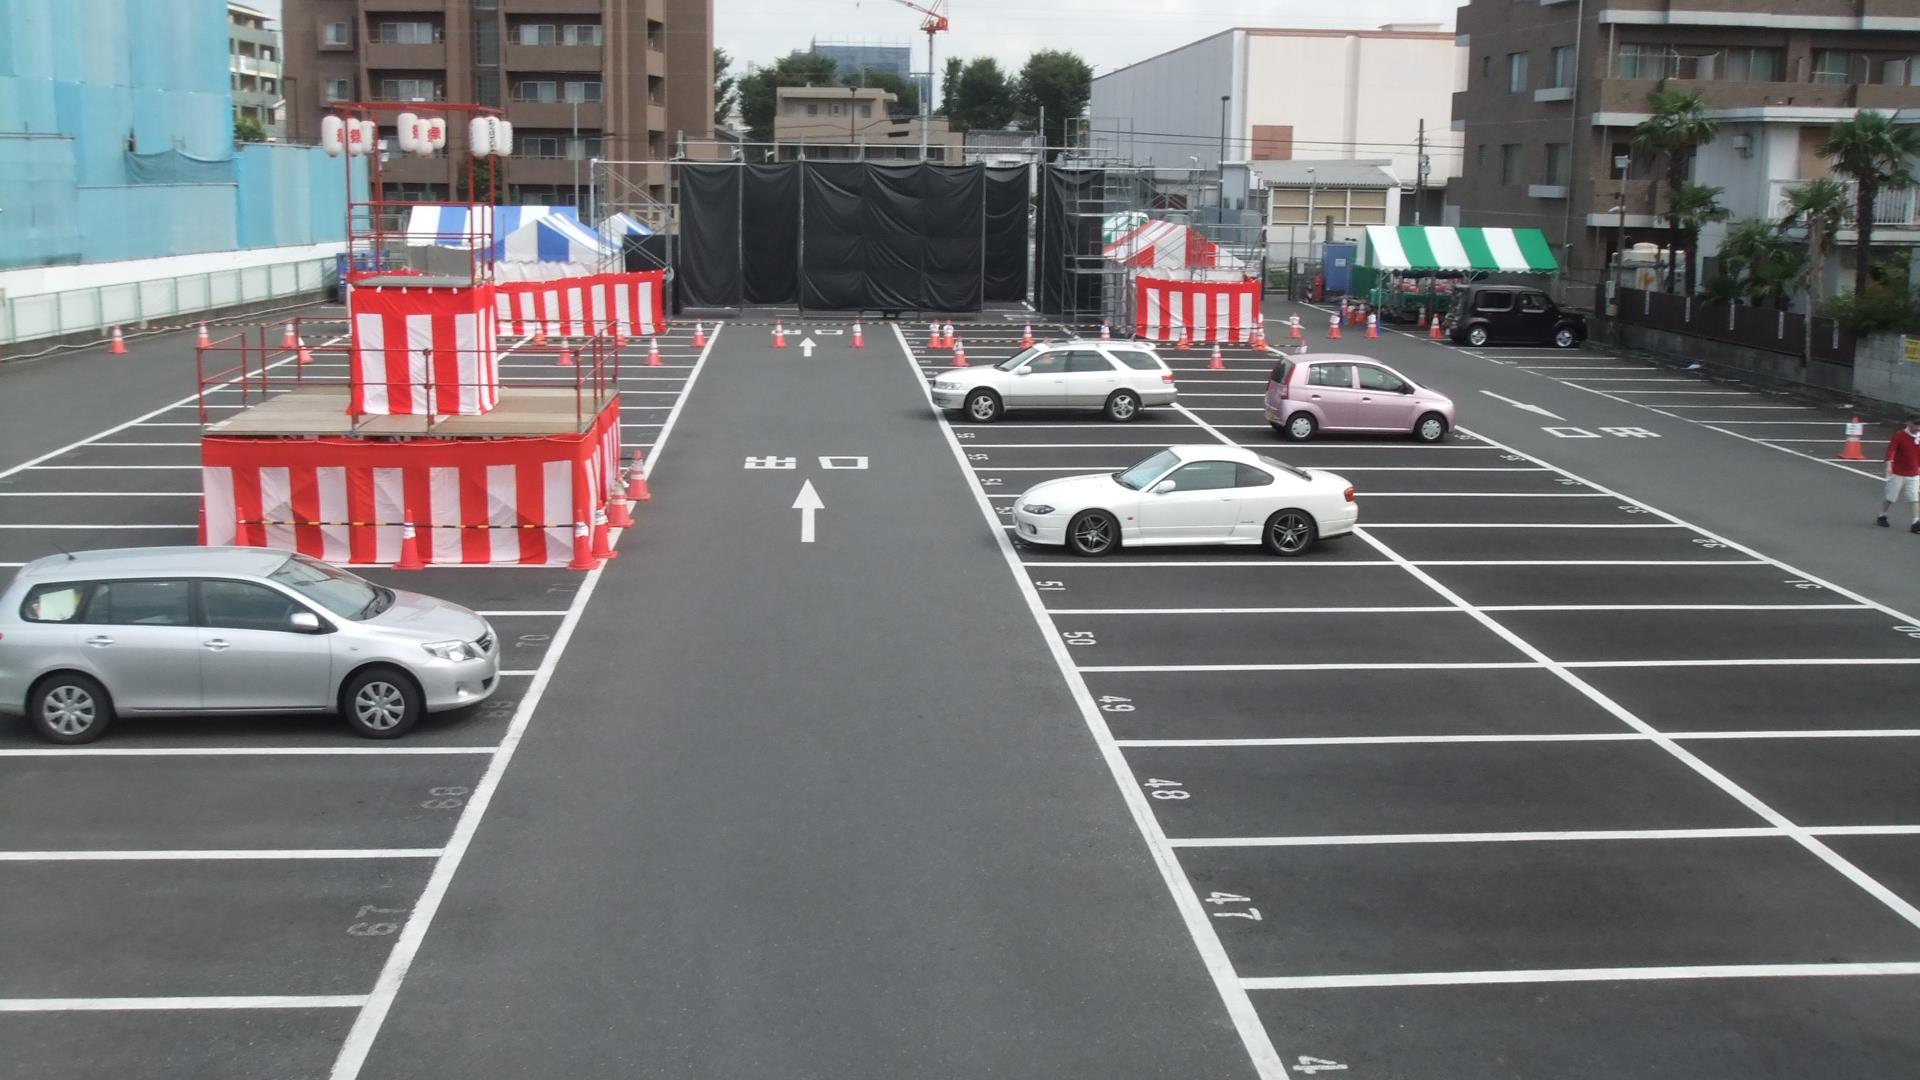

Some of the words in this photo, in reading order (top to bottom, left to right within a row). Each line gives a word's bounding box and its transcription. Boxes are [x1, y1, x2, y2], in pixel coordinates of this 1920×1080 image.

[1541, 426, 1662, 438] 出口
[744, 456, 869, 470] 出口
[1035, 580, 1066, 591] 51
[1063, 631, 1097, 646] 50
[1099, 695, 1136, 712] 49
[1144, 778, 1191, 800] 48
[1205, 891, 1262, 921] 47
